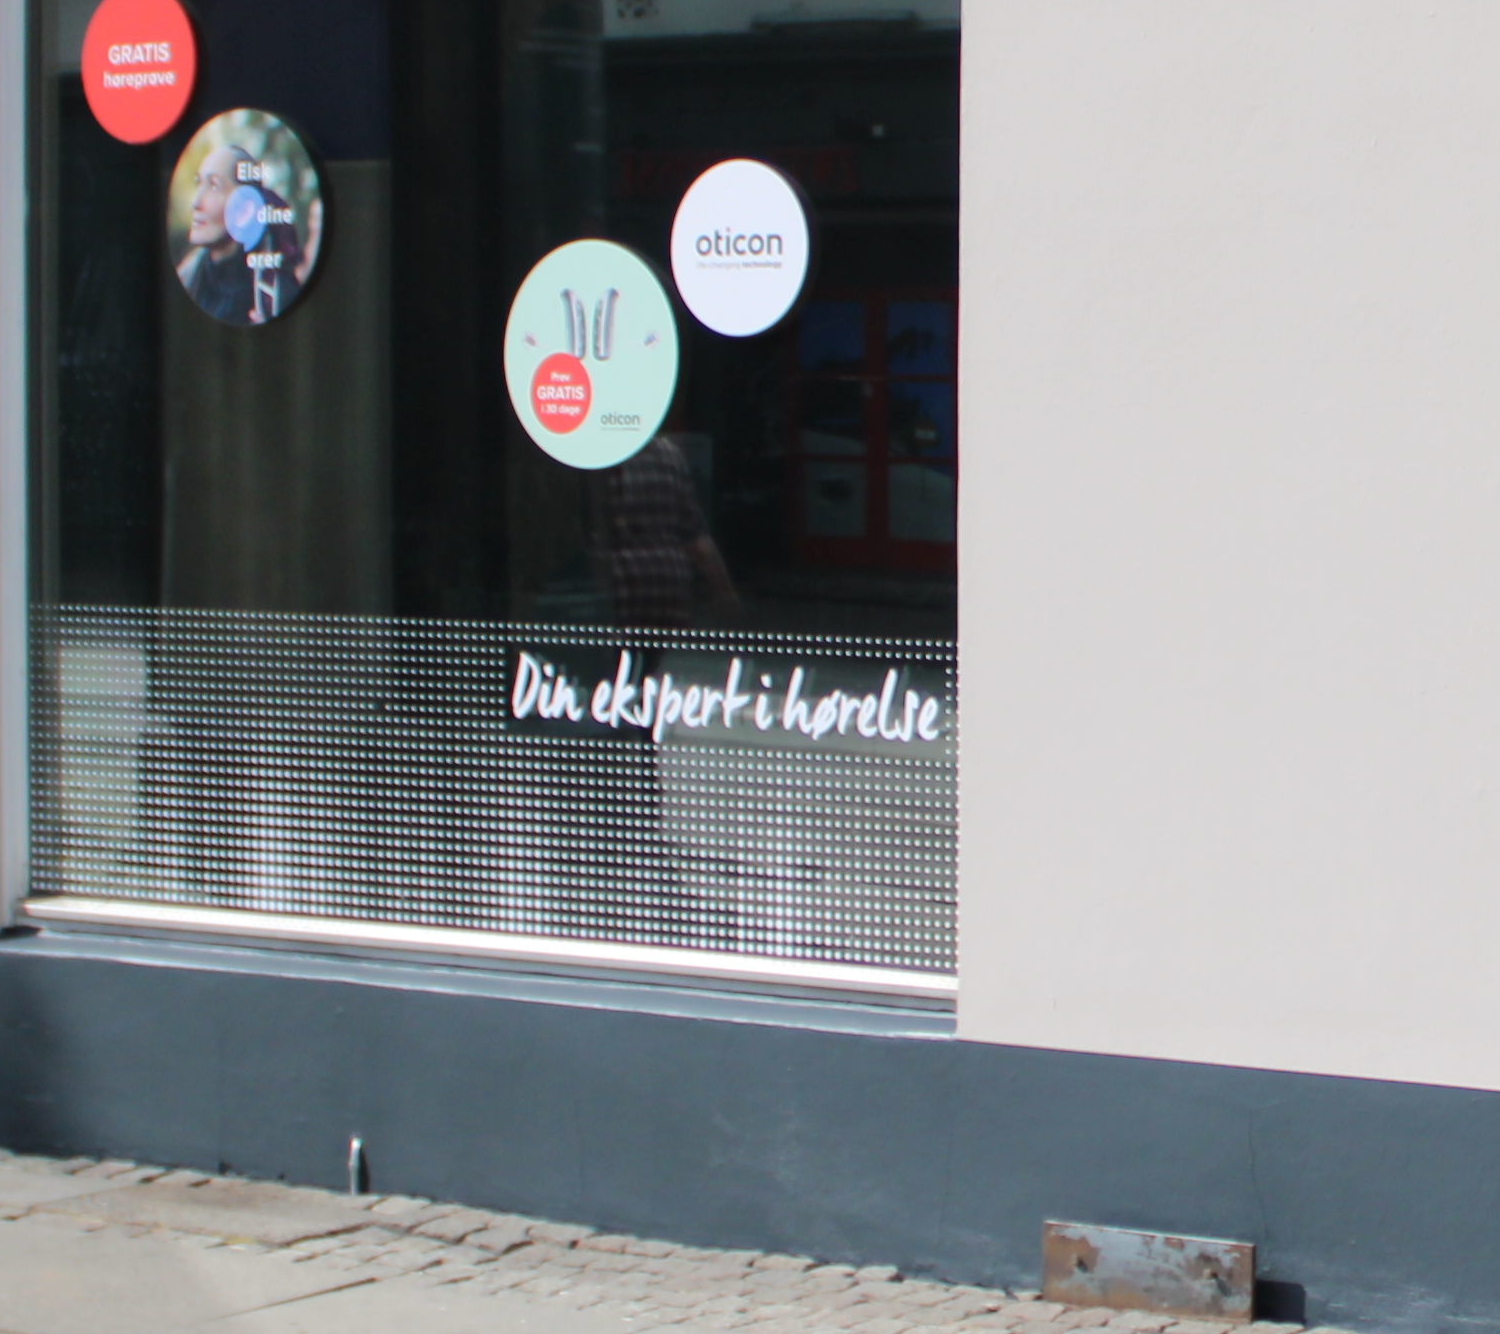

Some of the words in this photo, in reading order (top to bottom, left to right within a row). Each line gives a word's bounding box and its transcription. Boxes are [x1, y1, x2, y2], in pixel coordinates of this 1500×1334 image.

[107, 42, 171, 65] GRATIS
[103, 71, 176, 90] høreprøve
[237, 162, 270, 181] Elsk
[257, 205, 294, 224] dine
[695, 226, 783, 256] oticon
[246, 252, 284, 269] ører
[536, 386, 585, 401] GRATIS
[545, 404, 557, 414] 30
[558, 405, 581, 416] dage
[600, 411, 641, 426] oticon
[511, 650, 583, 722] Din
[590, 648, 751, 744] ekspert
[755, 673, 773, 731] i
[782, 666, 940, 742] hørelse
